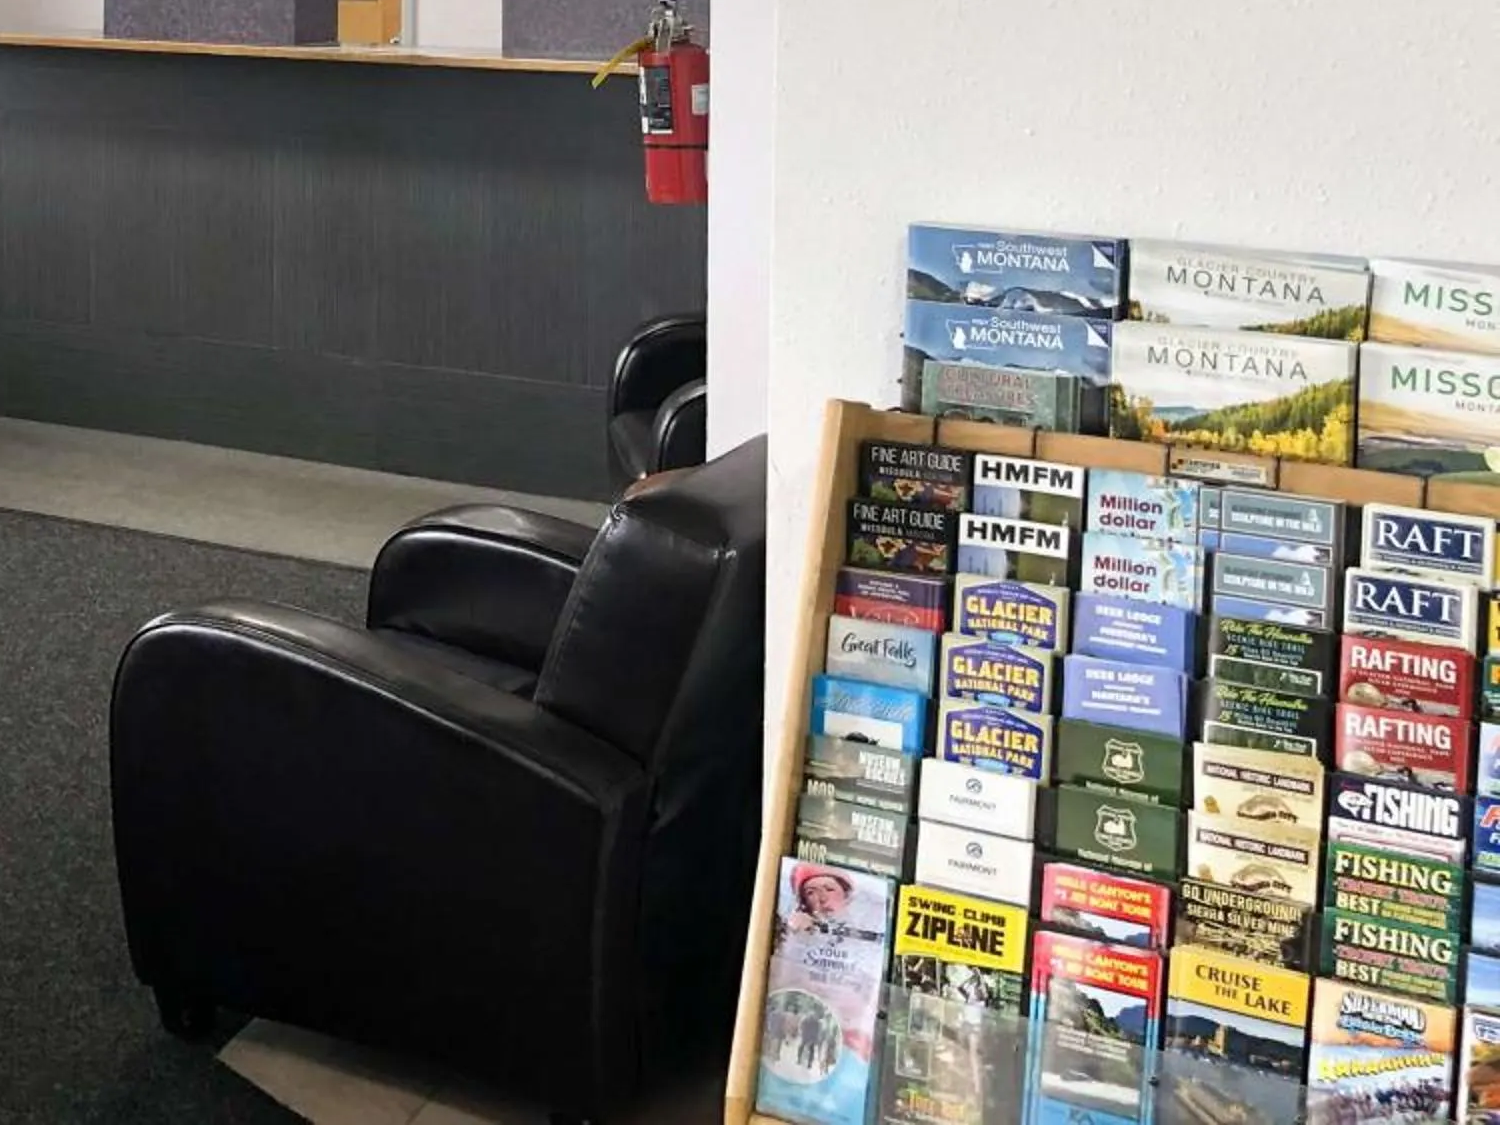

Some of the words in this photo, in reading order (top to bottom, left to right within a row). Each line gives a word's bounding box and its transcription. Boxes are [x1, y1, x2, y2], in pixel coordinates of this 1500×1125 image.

[977, 251, 1069, 272] MONTANA
[996, 241, 1067, 257] Southwest
[1177, 256, 1239, 273] GLACIER
[1245, 266, 1317, 284] COUNTRY
[1167, 266, 1325, 305] MONTANA
[1404, 280, 1494, 316] MISS
[970, 327, 1064, 350] MONTANA
[991, 317, 1061, 334] Southwest
[1466, 318, 1500, 332] MON
[1158, 336, 1220, 350] GLACIER
[1227, 344, 1299, 359] COUNTRY
[1148, 346, 1307, 380] MONTANA
[871, 446, 896, 463] FINE
[901, 449, 925, 466] ART
[927, 452, 964, 472] GUIDE
[981, 460, 1074, 489] HMFM
[853, 503, 879, 521] FINE
[882, 506, 907, 525] ART
[909, 510, 945, 530] GUIDE
[1100, 495, 1163, 515] Million
[967, 520, 1061, 550] HMFM
[1099, 512, 1156, 530] dollar
[1376, 518, 1482, 559] RAFT
[1094, 555, 1157, 577] Million
[1093, 574, 1150, 593] dollar
[966, 595, 1054, 625] GLACIER
[1356, 580, 1460, 622] RAFT
[967, 618, 1018, 630] NATIONAL
[1021, 623, 1048, 640] PARK
[841, 632, 881, 654] Great
[882, 638, 917, 668] Falls
[953, 656, 1039, 688] GLACIER
[1351, 646, 1457, 684] RAFTING
[955, 679, 1005, 694] NATIONAL
[1007, 685, 1036, 703] PARK
[951, 720, 1038, 752] GLACIER
[1345, 712, 1451, 750] RAFTING
[952, 743, 1001, 760] NATIONAL
[1003, 750, 1035, 769] PARK
[1363, 782, 1459, 840] FISHING
[1333, 851, 1452, 894] FISHING
[1183, 884, 1199, 898] GO
[1336, 891, 1380, 916] BEST
[908, 896, 955, 916] SWING
[963, 908, 1006, 926] CLIMB
[1187, 903, 1225, 922] SIERRA
[1227, 912, 1266, 932] SILVER
[1268, 921, 1297, 938] MINE
[906, 911, 1005, 956] ZIPLINE
[1334, 917, 1452, 963] FISHING
[1195, 963, 1263, 993] CRUISE
[1336, 959, 1380, 984] BEST
[1214, 985, 1238, 1000] THE
[1244, 991, 1293, 1016] LAKE
